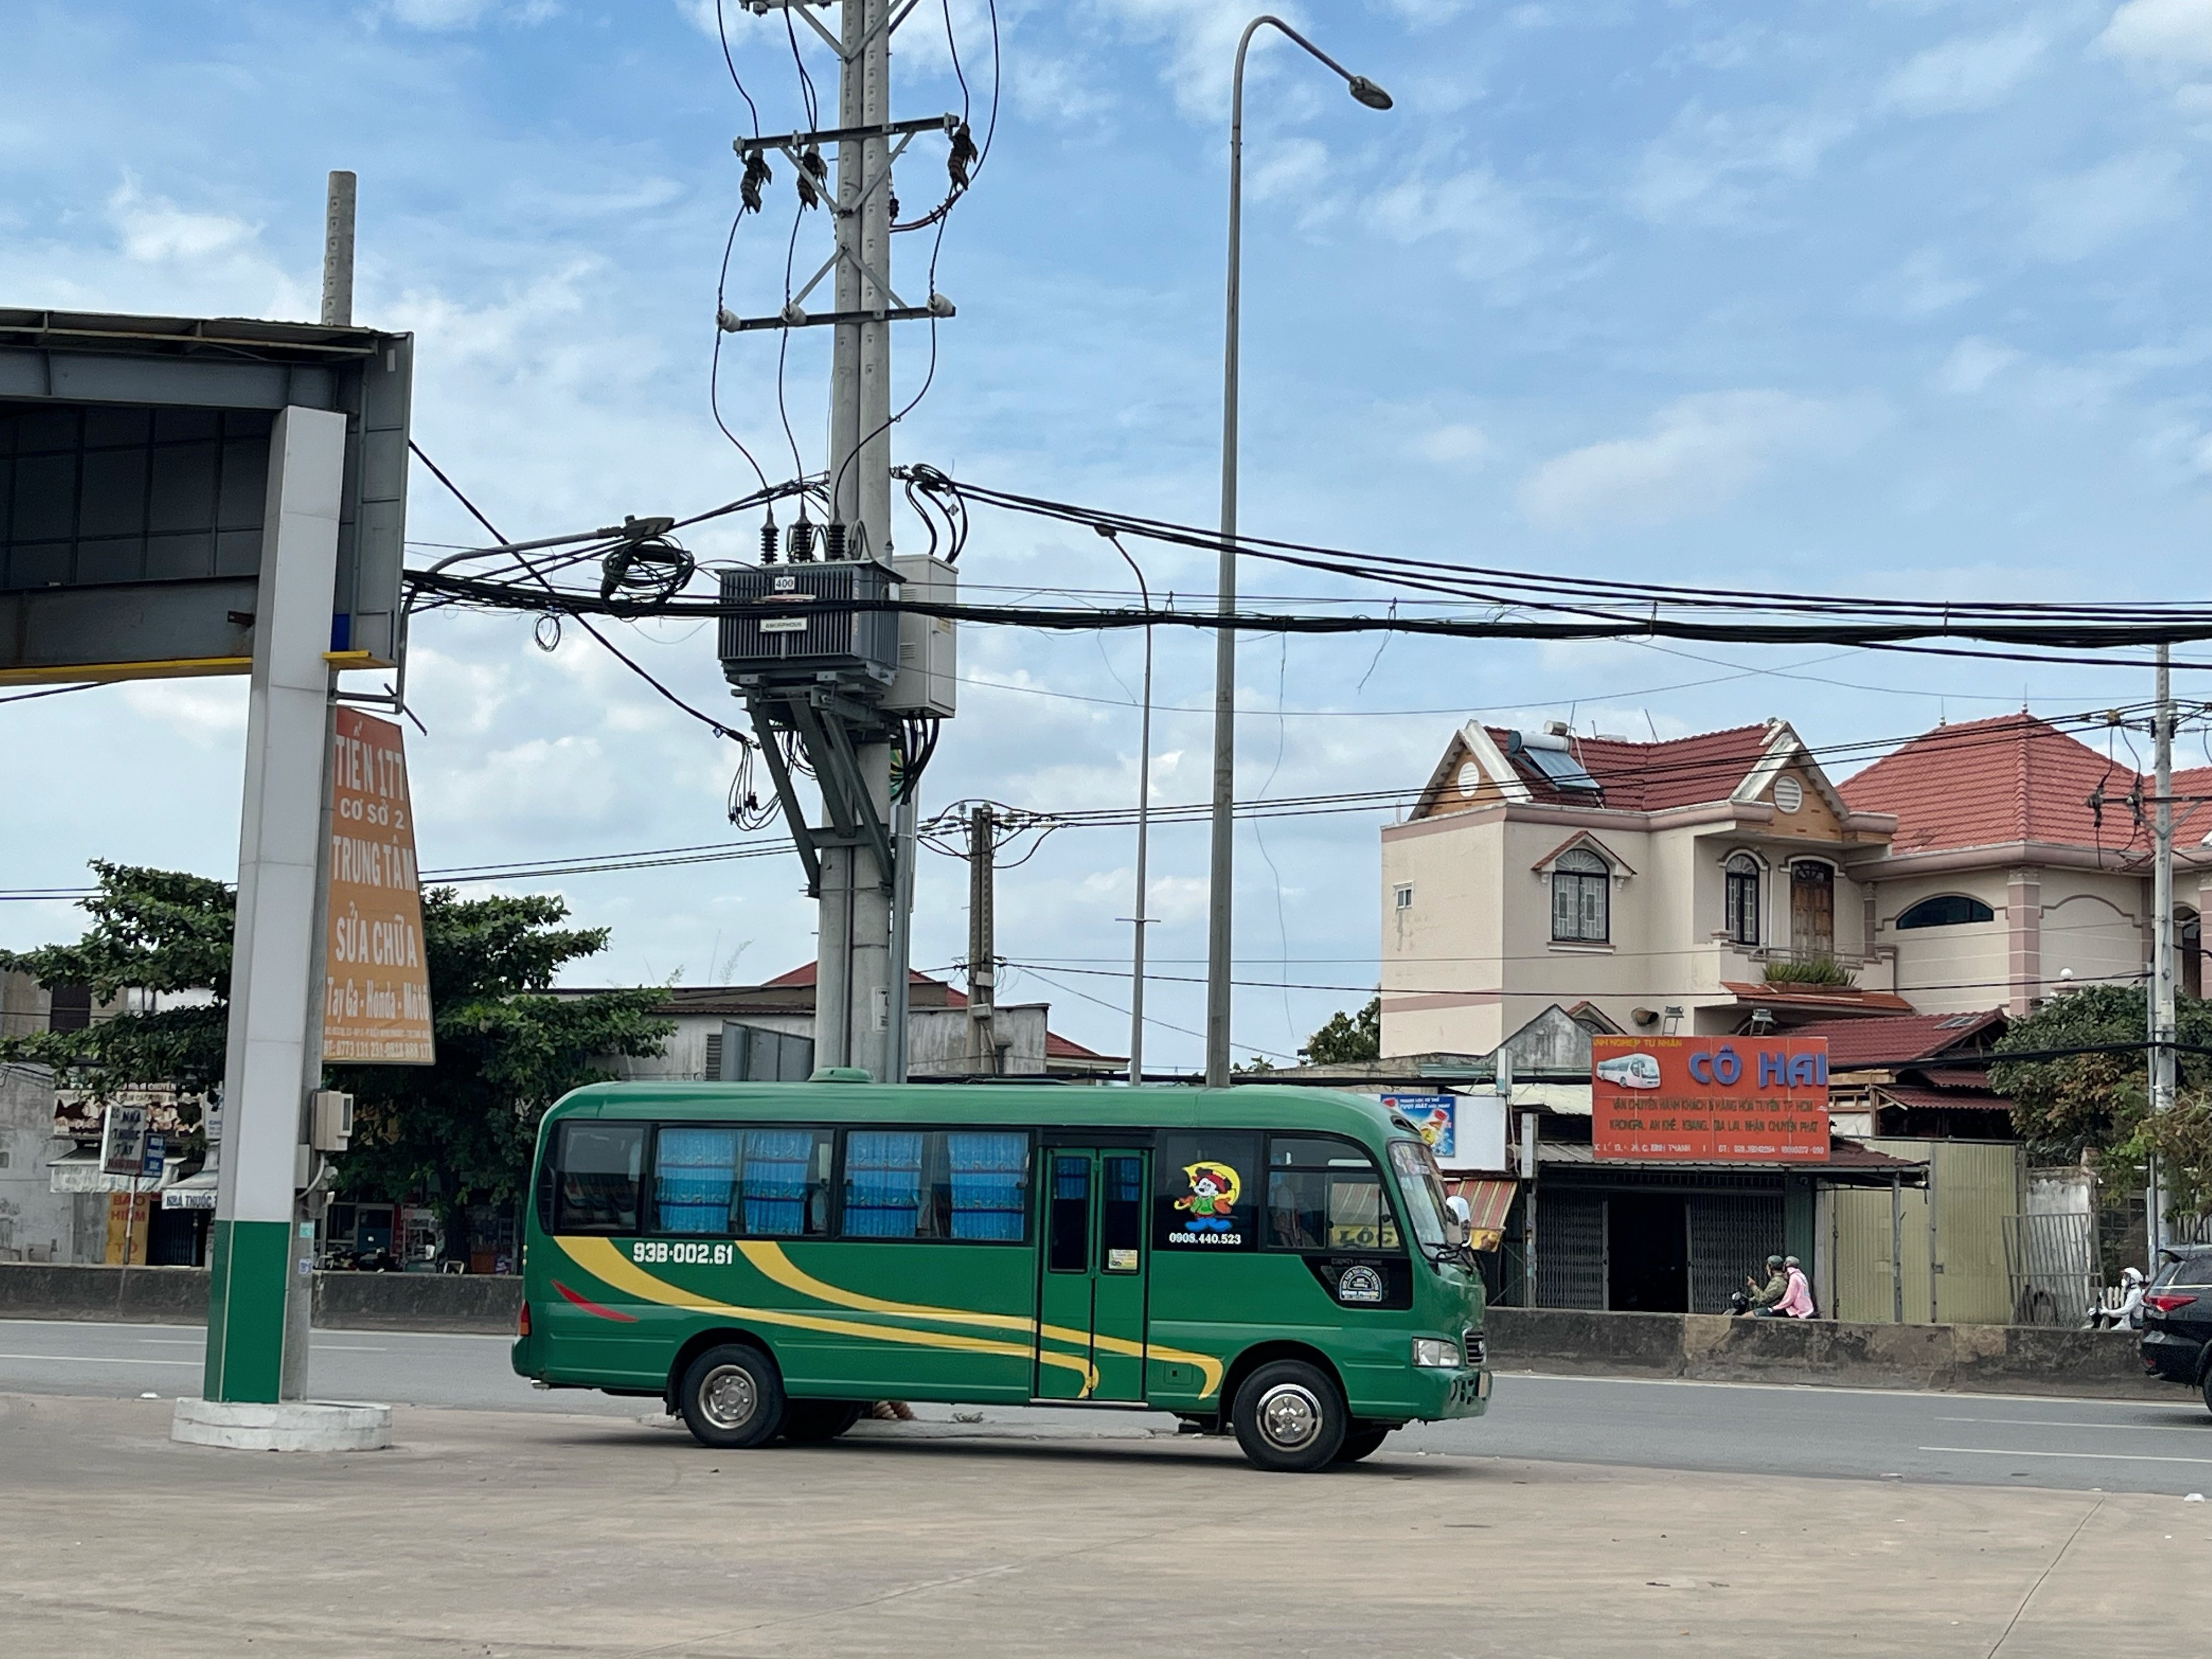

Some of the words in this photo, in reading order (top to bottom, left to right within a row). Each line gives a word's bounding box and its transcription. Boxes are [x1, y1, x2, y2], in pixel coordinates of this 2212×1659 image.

[776, 579, 794, 588] 400
[336, 720, 374, 794] TIẾN
[377, 747, 404, 801] 177
[340, 798, 364, 821] CƠ
[367, 798, 389, 826] SỞ
[394, 810, 405, 830] 2
[333, 835, 381, 887] TRUNG
[383, 834, 417, 892] TÂM
[336, 900, 369, 963] SỬA
[373, 913, 418, 968] CHỮA
[327, 977, 345, 1024] Tay
[346, 978, 358, 1017] Ga
[366, 979, 396, 1019] Honda
[1688, 1044, 1742, 1086] CÔ
[1758, 1051, 1827, 1088] HAI
[1169, 1233, 1242, 1244] 0908.440.523
